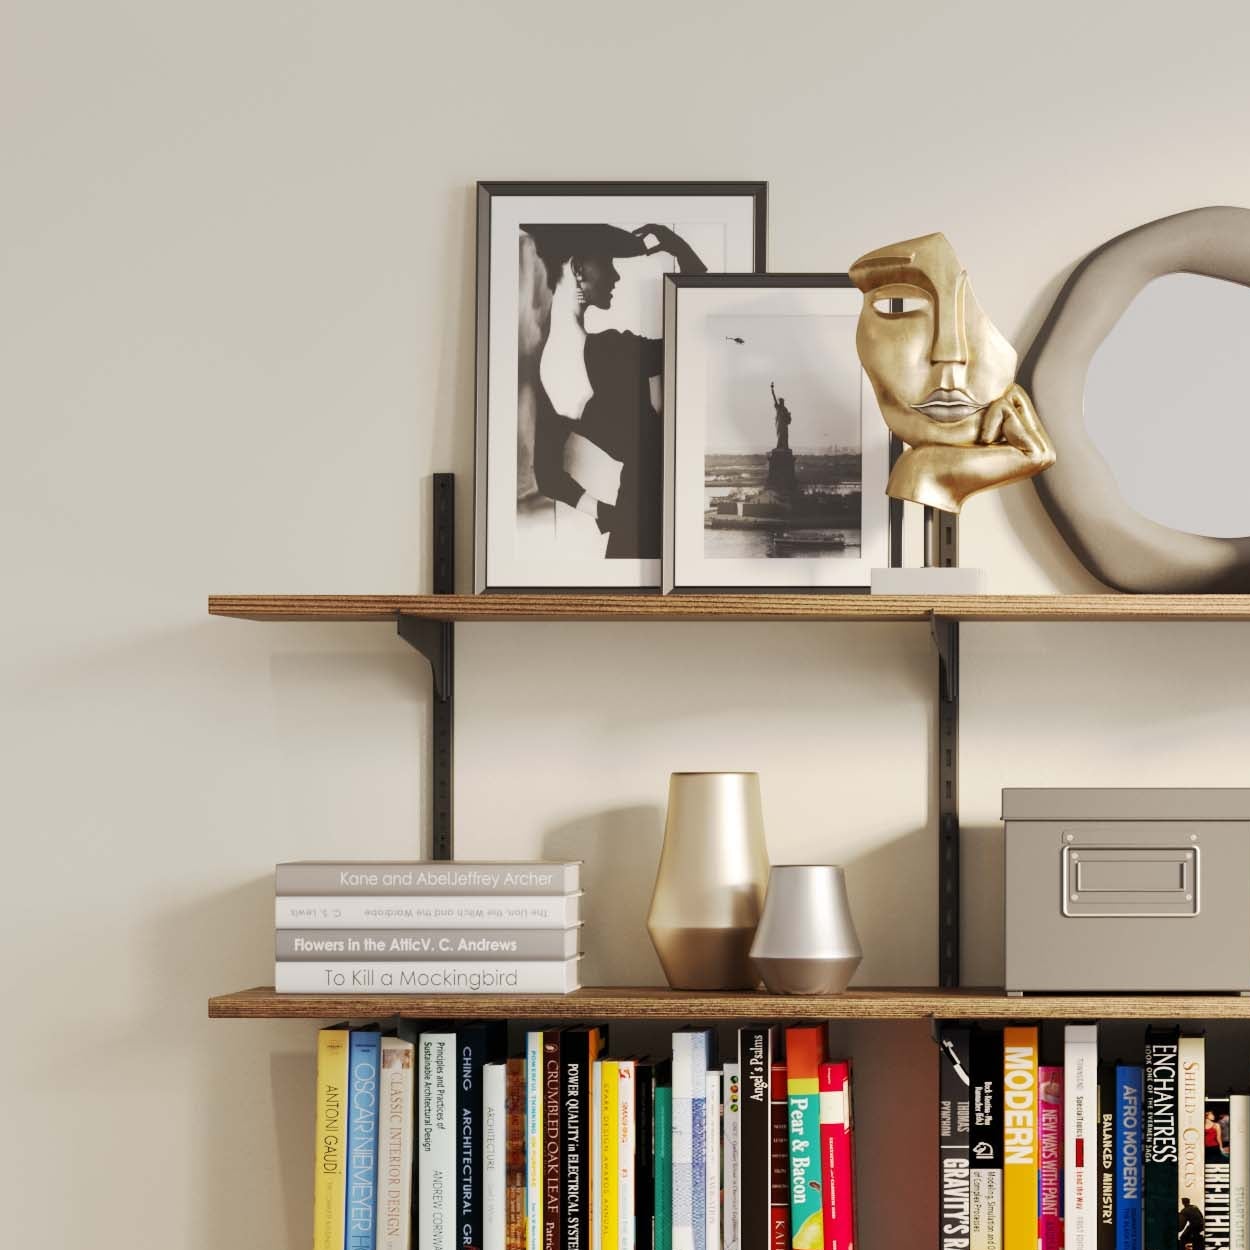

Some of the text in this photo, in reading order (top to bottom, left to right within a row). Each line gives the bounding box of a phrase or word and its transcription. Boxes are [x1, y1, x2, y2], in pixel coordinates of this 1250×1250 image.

[340, 872, 378, 886] Kane
[382, 872, 412, 886] and
[504, 872, 552, 886] Archer
[294, 939, 344, 951] Flowers
[348, 939, 360, 951] in
[363, 939, 385, 951] the
[438, 939, 453, 951] C.
[457, 939, 517, 951] Andrews
[325, 969, 518, 989] To Kill a Mockingbird
[435, 1042, 445, 1130] Principles and Practices of
[462, 1046, 472, 1091] CHING
[567, 1064, 579, 1097] POWER
[750, 1035, 765, 1101] Angel's Psalms
[323, 1085, 339, 1133] ANTONI
[353, 1063, 375, 1132] OSCAR
[390, 1072, 404, 1123] CLASSIC
[422, 1042, 432, 1152] Sustainable Architectural Design
[565, 1099, 579, 1142] QUALITY
[940, 1101, 951, 1136] PYNCHON
[957, 1101, 969, 1132] THOMAS
[1004, 1047, 1034, 1165] MODERN
[1041, 1109, 1058, 1131] NEW
[1122, 1085, 1137, 1128] AFRO
[1151, 1045, 1177, 1162] ENCHANTRESS
[486, 1107, 495, 1171] ARCHITECTURE
[547, 1060, 558, 1213] CRUMBLED OAK LEAF
[568, 1144, 579, 1152] in
[1041, 1133, 1058, 1159] WAYS
[1182, 1061, 1200, 1188] SHIELD CROCUS
[388, 1127, 403, 1186] INTERIOR
[462, 1108, 472, 1215] ARCHITECTURAL
[790, 1098, 810, 1204] Pear & Bacon
[1041, 1161, 1058, 1185] WITH
[1102, 1113, 1112, 1224] BALANCED MINISTRY
[1123, 1131, 1137, 1199] MODERN
[1145, 1145, 1153, 1162] SAGA
[352, 1135, 375, 1231] NIEMEYER
[433, 1170, 443, 1209] ANDREW
[567, 1154, 579, 1215] ELECTRICAL
[943, 1158, 969, 1234] GRAVITY'S
[1041, 1187, 1058, 1217] PAINT
[386, 1190, 401, 1236] DESIGN
